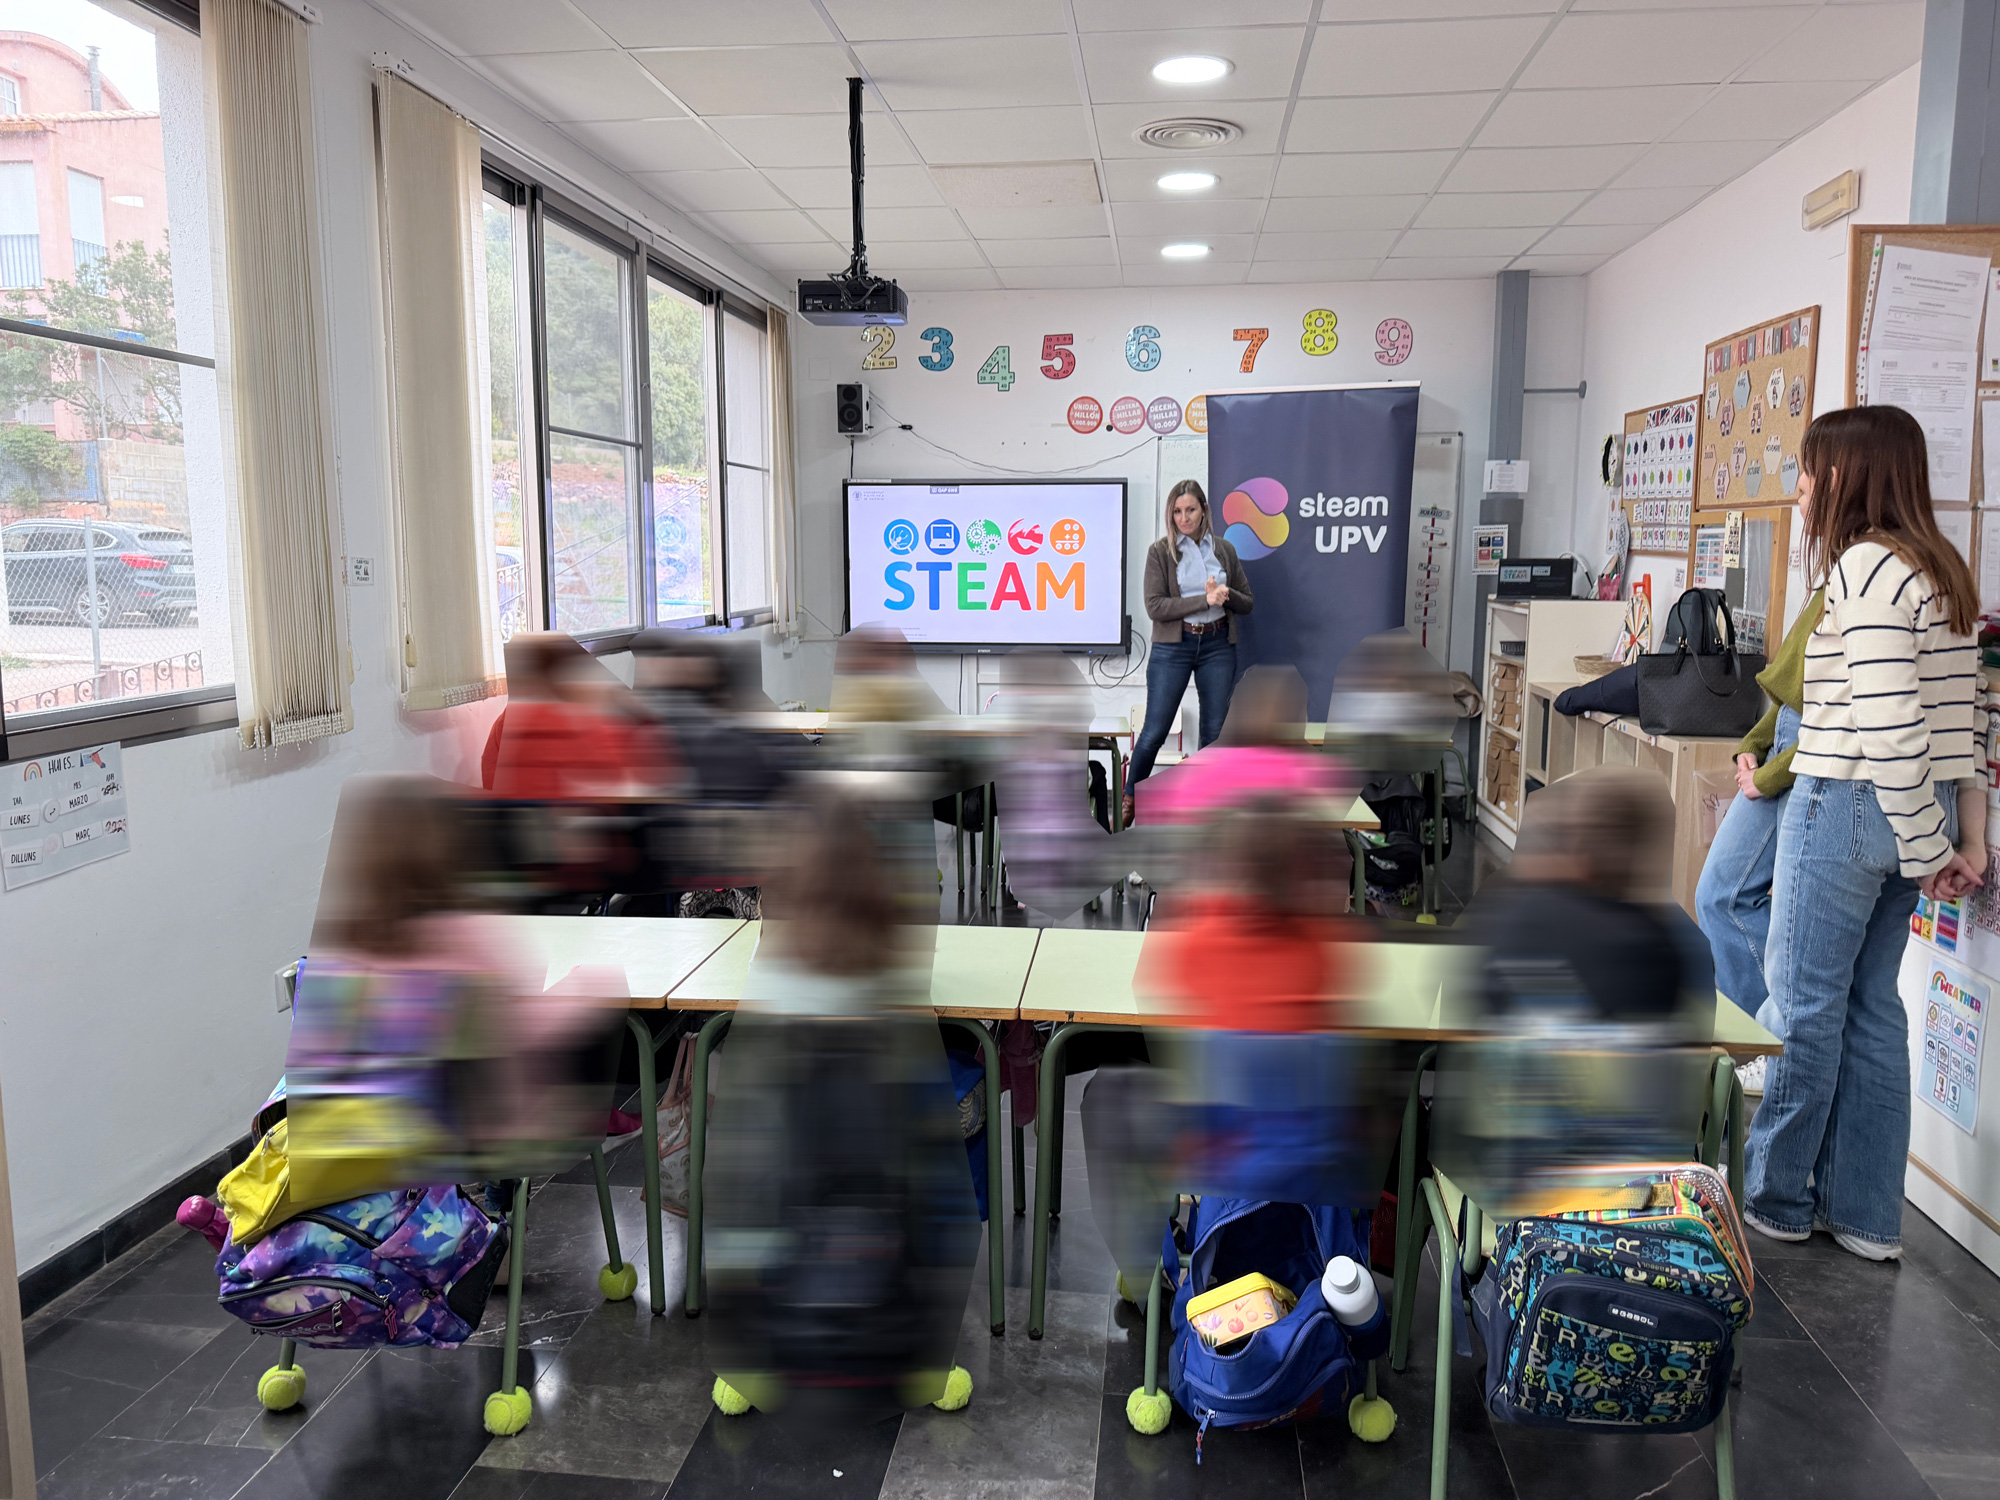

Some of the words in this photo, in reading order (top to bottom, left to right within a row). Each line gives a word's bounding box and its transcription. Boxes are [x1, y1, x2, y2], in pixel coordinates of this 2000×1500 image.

[1300, 308, 1338, 356] 8
[1374, 318, 1413, 366] 9
[861, 326, 897, 370] 2
[918, 327, 954, 372] 3
[977, 346, 1015, 392] 4
[1040, 333, 1076, 379] 5
[1126, 325, 1161, 372] 6
[1233, 328, 1269, 373] 7
[1074, 402, 1098, 410] UNIDAD
[1114, 402, 1140, 412] CENTENA
[1150, 402, 1177, 412] DECENA
[1116, 410, 1140, 419] MILLAR
[1153, 411, 1178, 420] MILLAR
[1154, 421, 1177, 429] 10.000
[1299, 492, 1388, 518] steam
[1315, 525, 1388, 553] UPV
[884, 561, 1086, 611] STEAM
[69, 794, 88, 808] MARZO
[10, 814, 30, 826] LUNES
[76, 828, 90, 841] MARÇ
[11, 852, 36, 864] DILLUNS
[1940, 979, 1982, 1014] WEATHER
